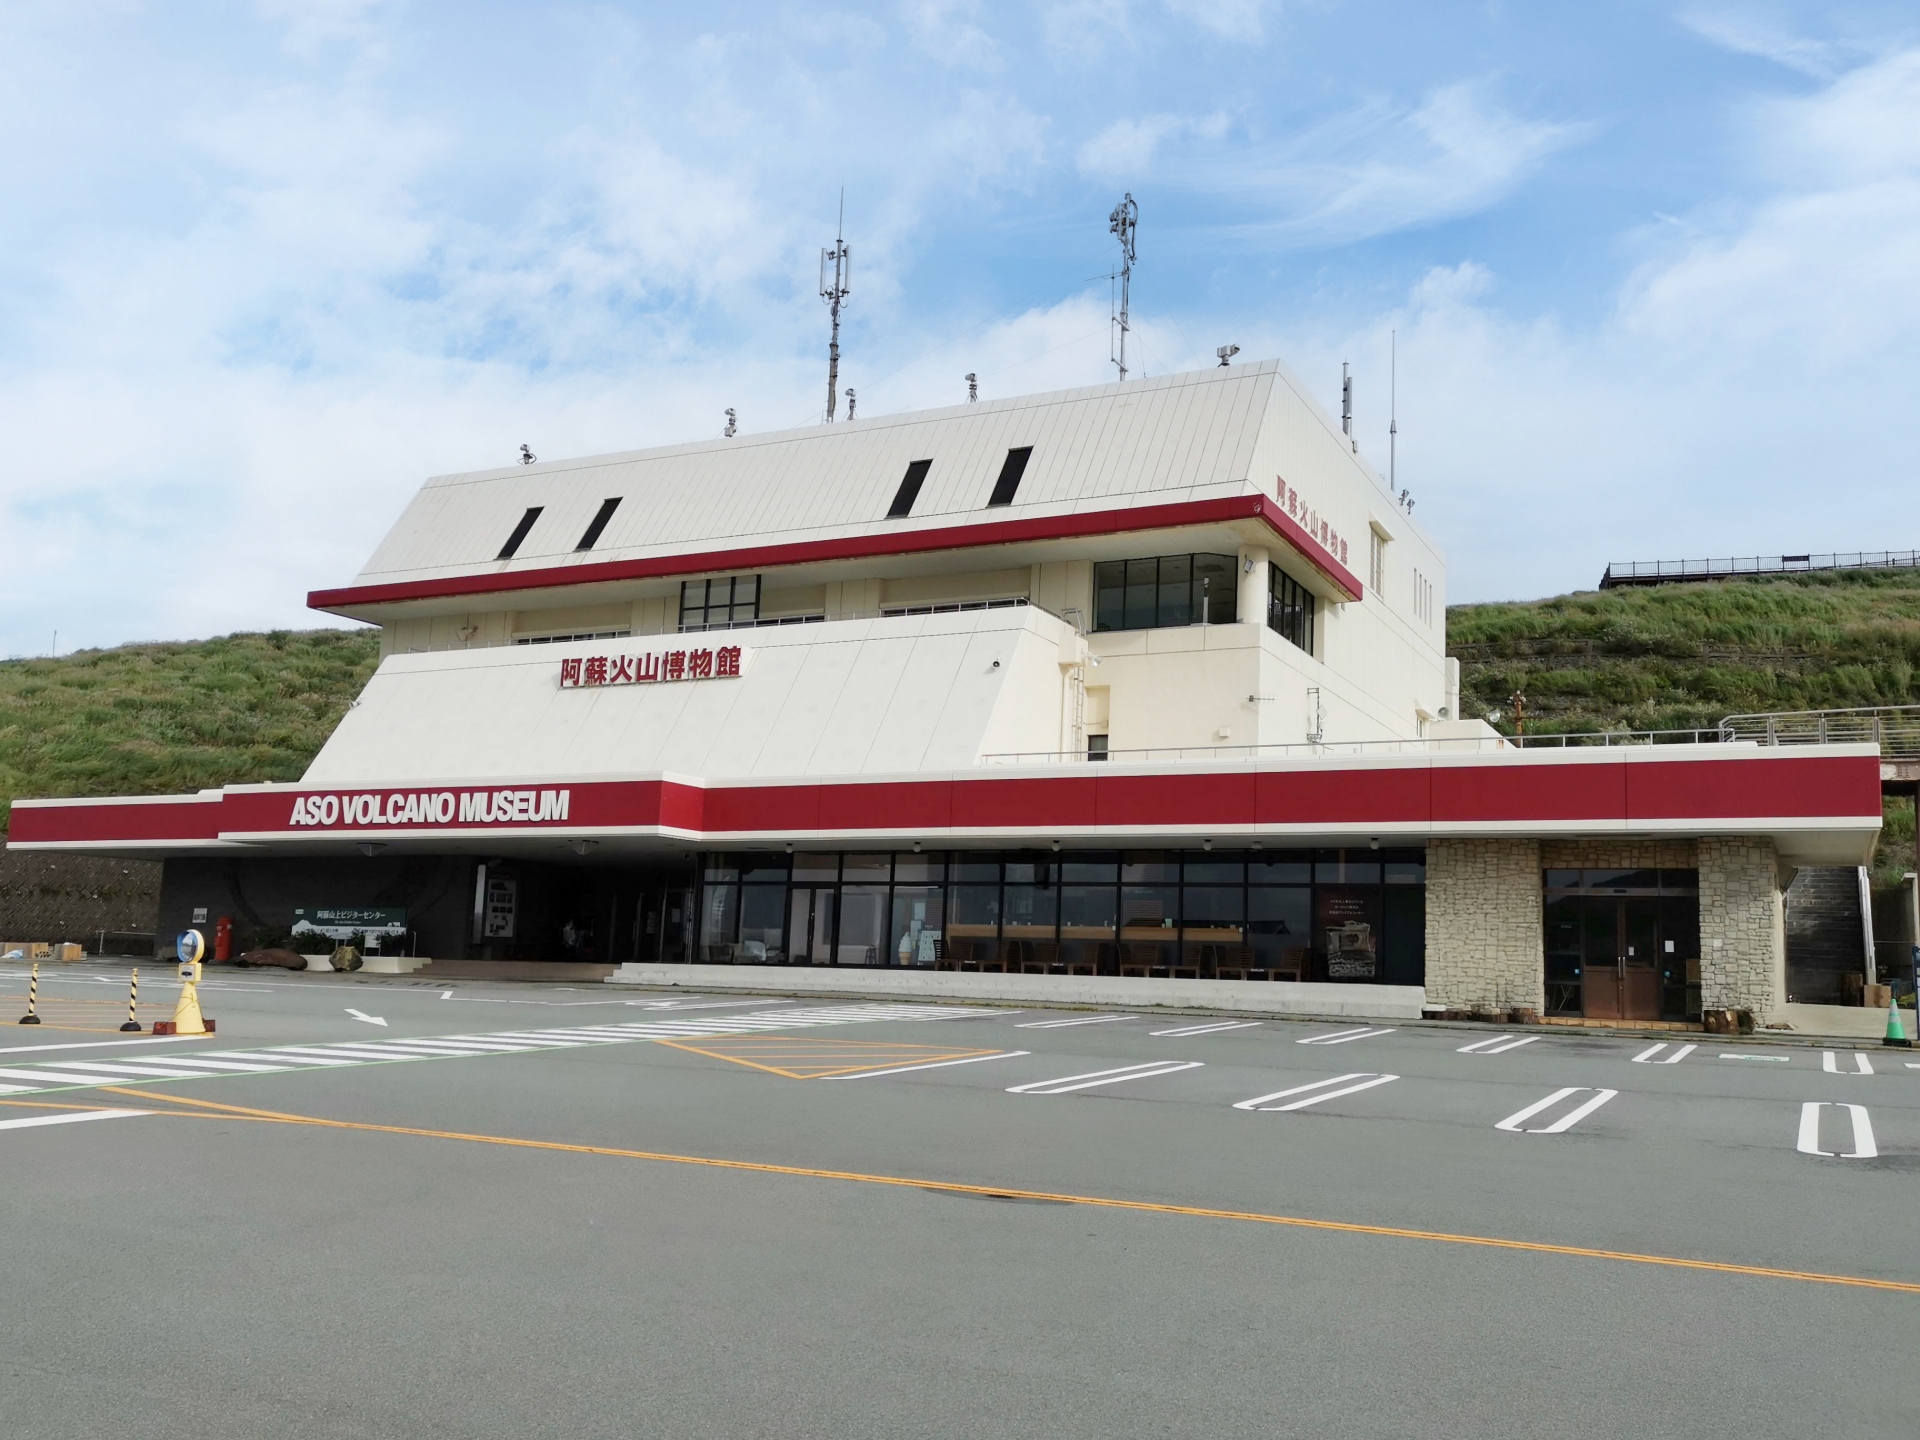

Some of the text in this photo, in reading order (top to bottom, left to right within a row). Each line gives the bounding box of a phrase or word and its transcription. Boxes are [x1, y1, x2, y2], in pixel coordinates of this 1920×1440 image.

[560, 645, 742, 687] 阿蘇火山博物館
[289, 789, 571, 826] ASO VOLCANO MUSEUM
